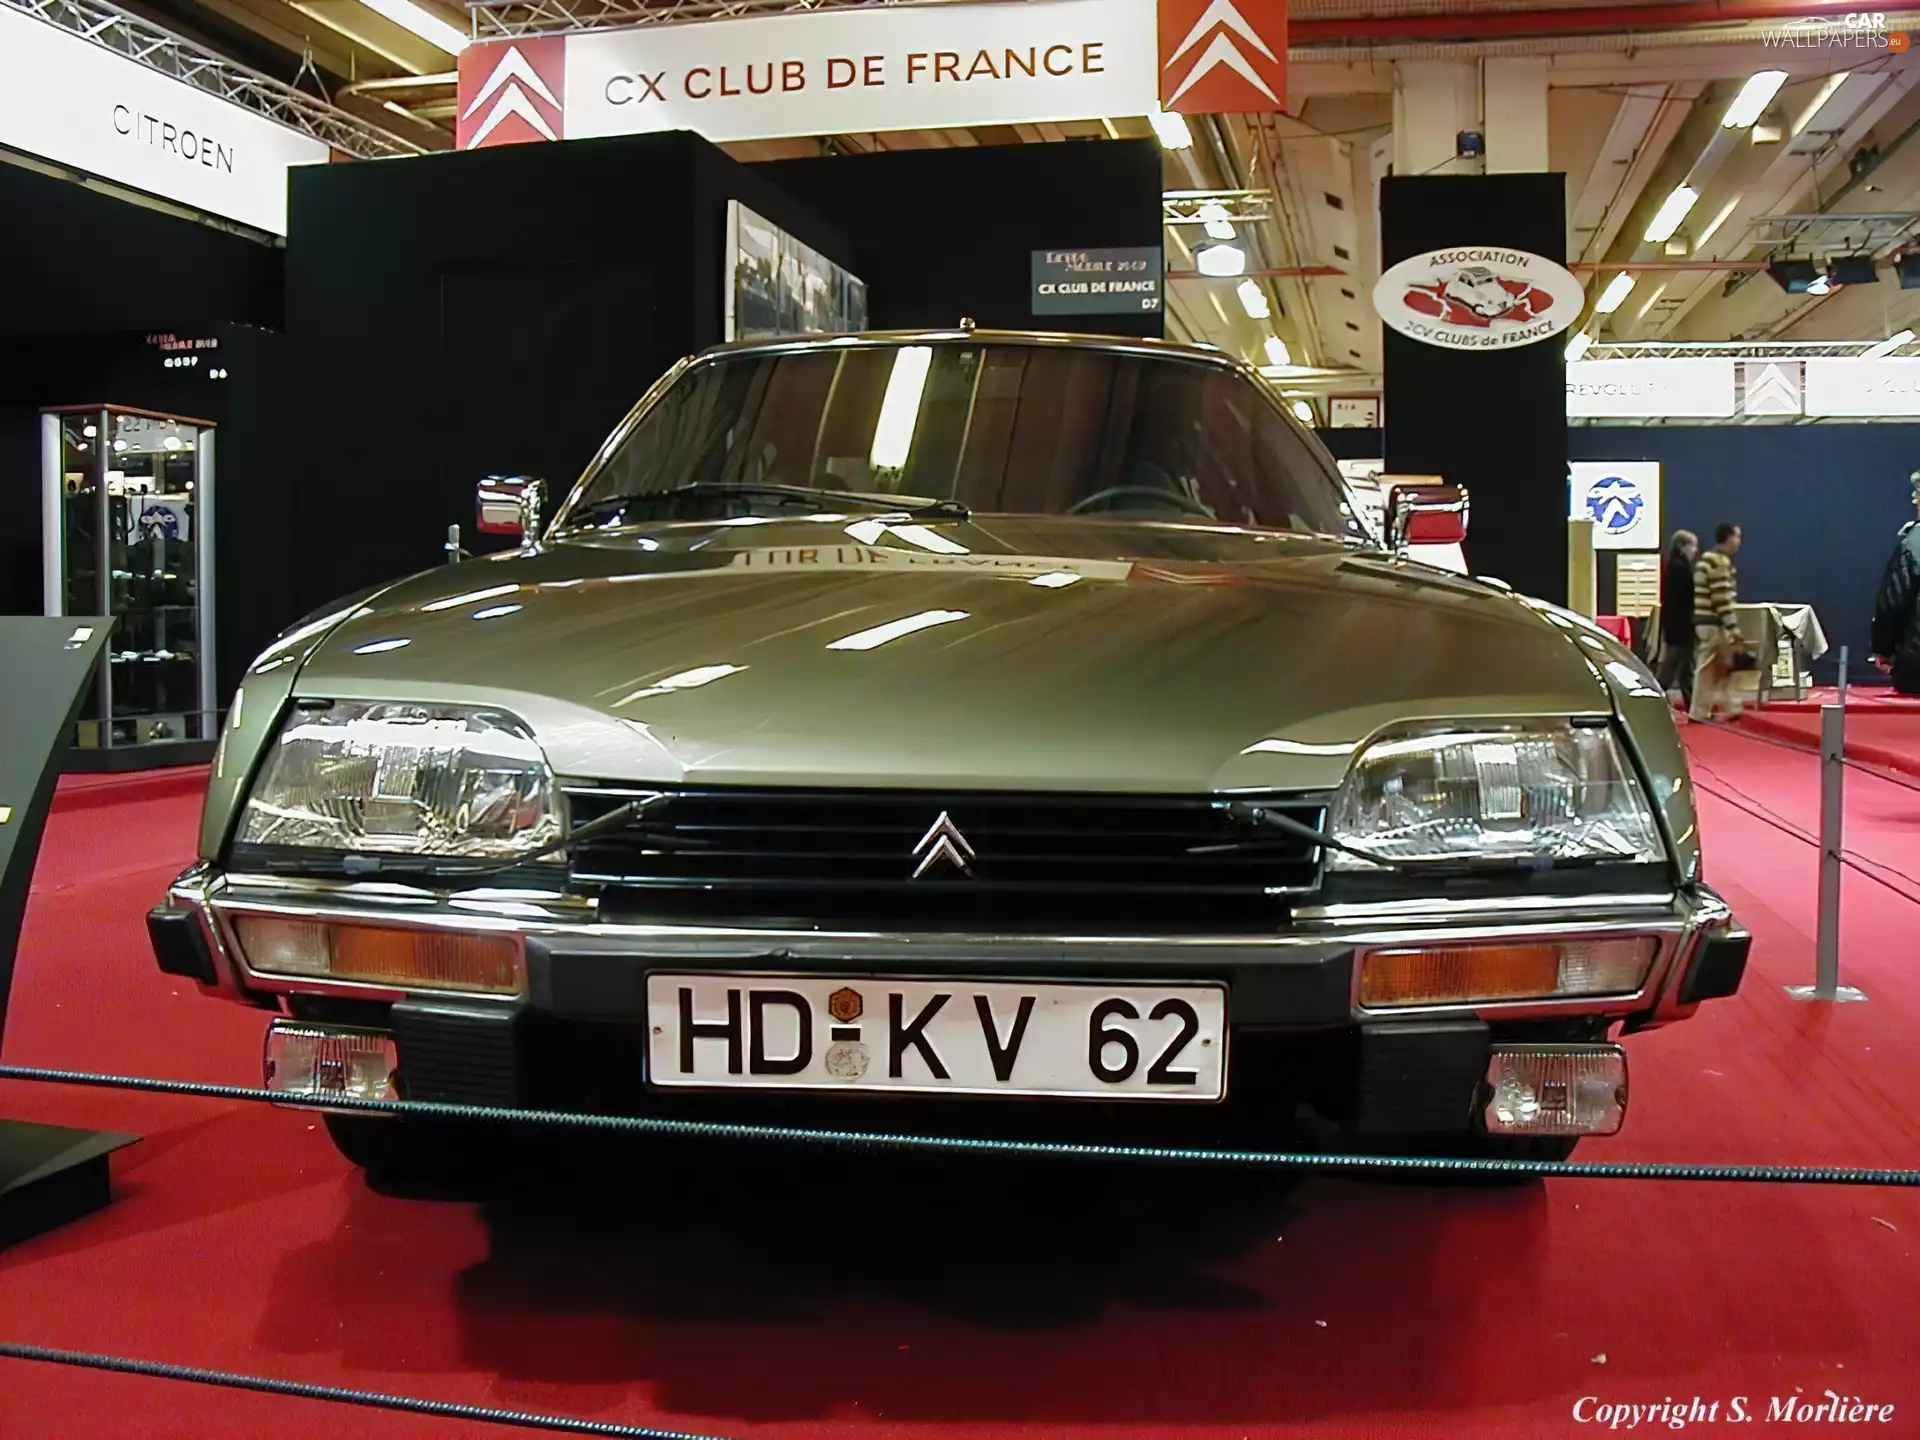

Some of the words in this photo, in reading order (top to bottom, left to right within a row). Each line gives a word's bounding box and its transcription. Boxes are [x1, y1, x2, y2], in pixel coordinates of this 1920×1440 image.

[604, 71, 667, 106] CX
[684, 61, 806, 99] CLUB
[827, 55, 885, 89] DE
[906, 42, 1105, 84] FRANCE
[113, 104, 233, 174] CITROEN
[1429, 250, 1530, 268] ASSOCIATION
[1038, 283, 1056, 294] CX
[1058, 282, 1089, 294] CLUB
[1091, 281, 1106, 293] DE
[1108, 280, 1156, 293] FRANCE
[1403, 320, 1433, 338] 2CV
[1434, 329, 1478, 346] CLUBS
[1480, 335, 1498, 346] de
[1502, 320, 1554, 345] FRANCE
[1088, 998, 1200, 1085] 62
